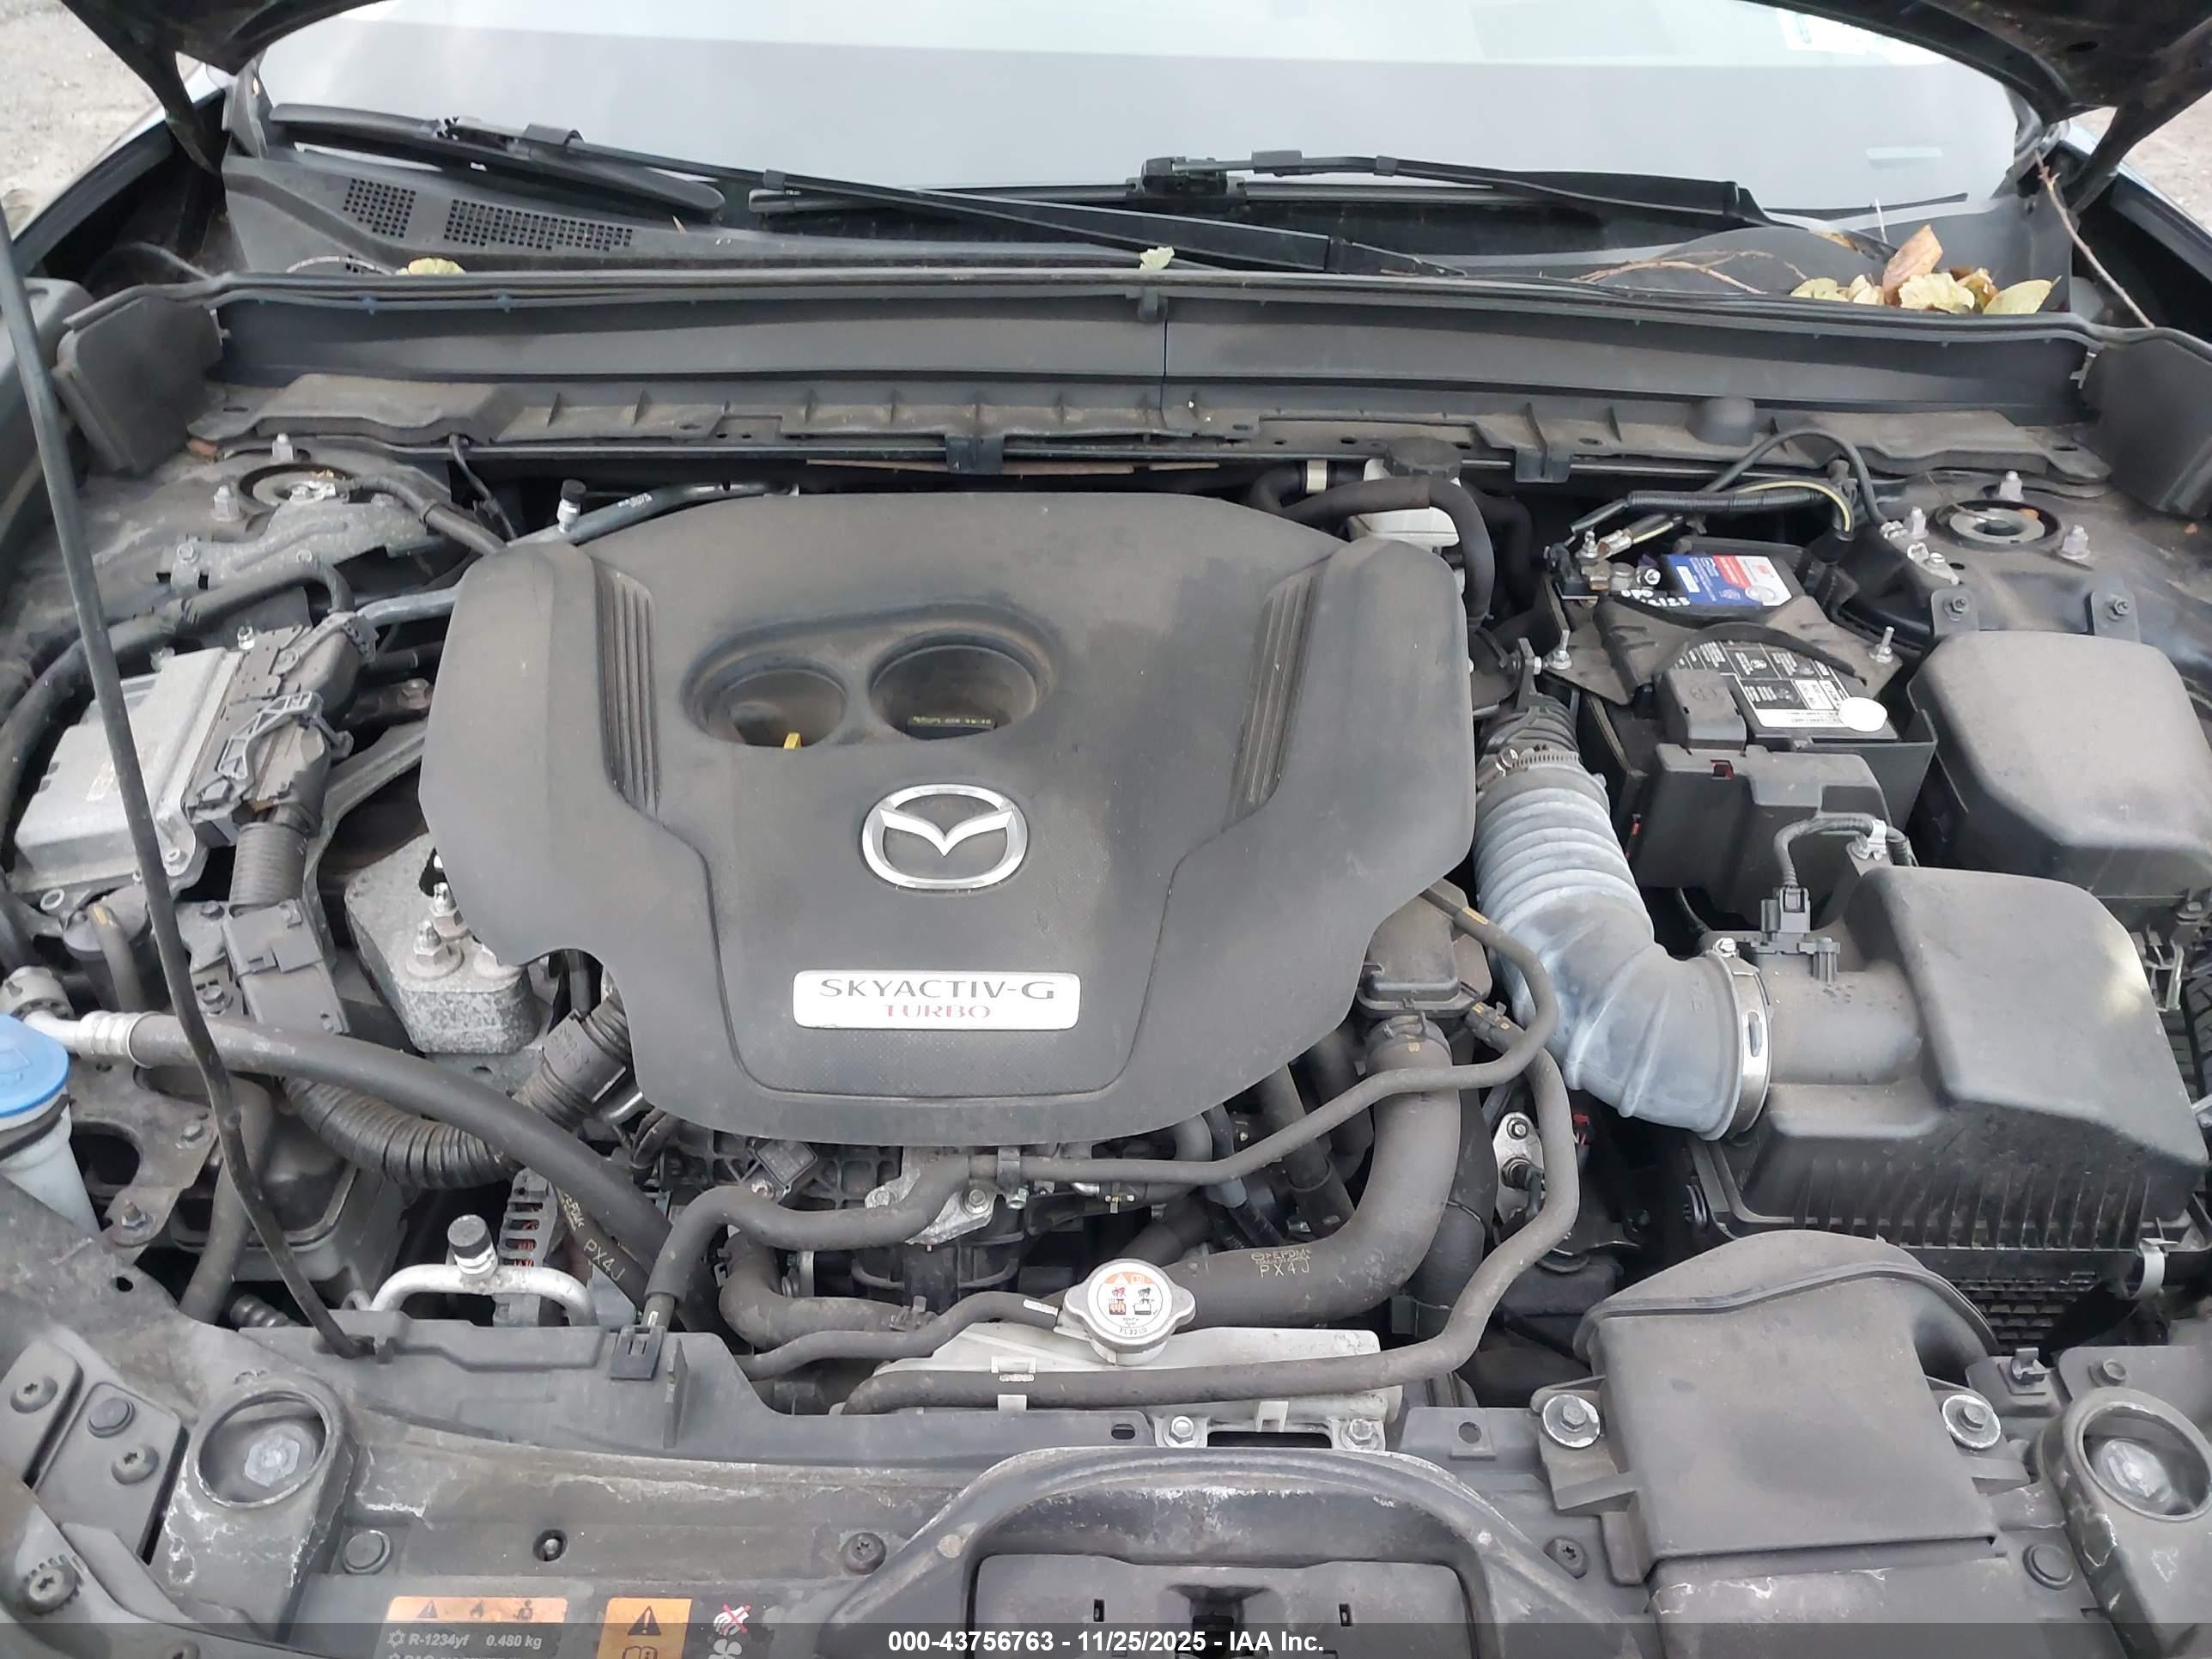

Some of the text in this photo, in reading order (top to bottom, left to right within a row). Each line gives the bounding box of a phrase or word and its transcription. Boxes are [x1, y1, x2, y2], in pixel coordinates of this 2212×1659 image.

[819, 979, 1055, 1000] SKYACTIV-G
[884, 1005, 991, 1018] TURBO
[583, 1238, 625, 1280] PX4J
[1260, 1258, 1310, 1278] PX4J
[408, 1633, 543, 1650] R-1234yf 0.480 kg
